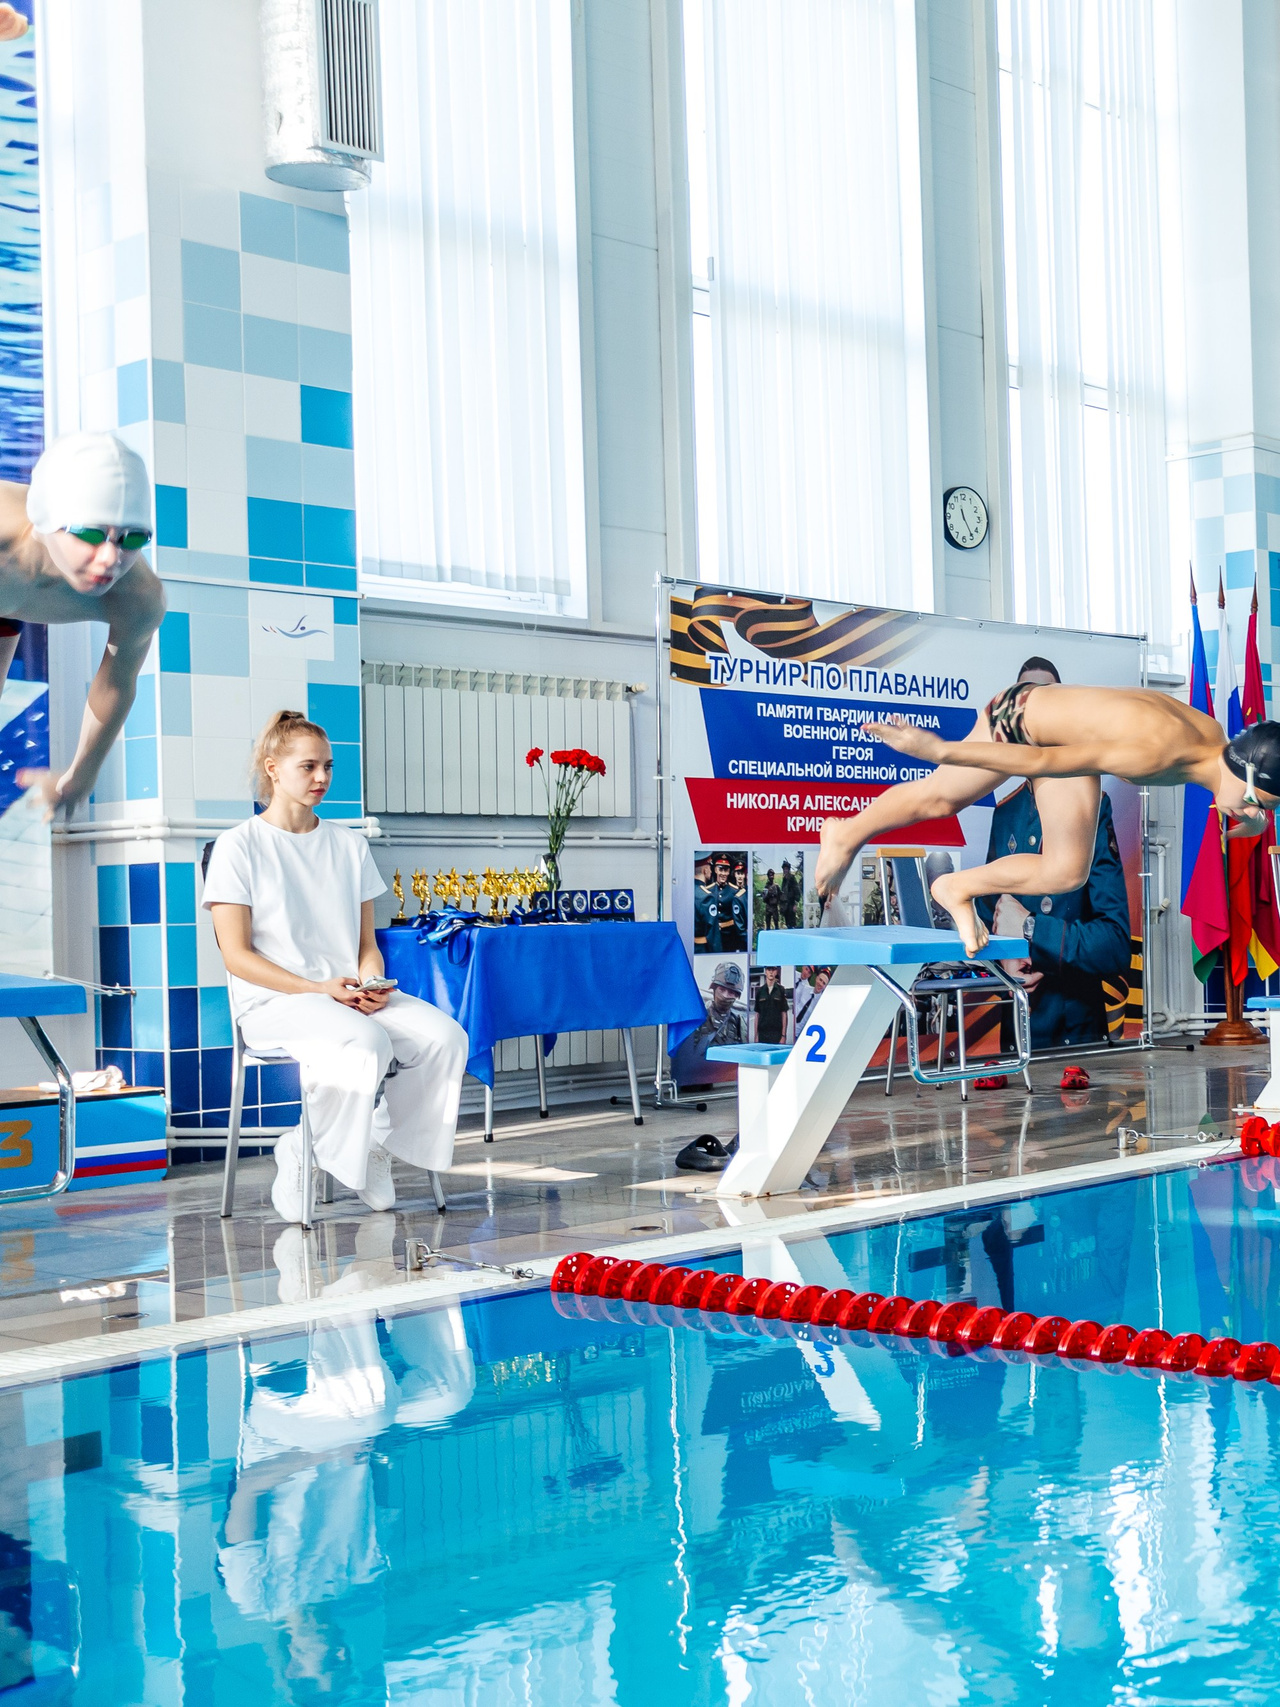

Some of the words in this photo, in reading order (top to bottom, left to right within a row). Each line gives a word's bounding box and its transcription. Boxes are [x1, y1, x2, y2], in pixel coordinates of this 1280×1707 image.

[708, 655, 802, 687] ТУРНИР
[810, 665, 842, 691] ПО
[850, 668, 969, 701] ПЛАВАНИЮ
[757, 702, 813, 721] ПАМЯТИ
[816, 706, 875, 726] ГВАРДИИ
[877, 711, 941, 729] КАПИТАНА
[783, 724, 848, 742] ВОЕННОЙ
[851, 728, 889, 744] РАЗВ
[832, 746, 874, 761] ГЕРОЯ
[728, 759, 833, 778] СПЕЦИАЛЬНОЙ
[836, 763, 897, 781] ВОЕННОЙ
[900, 767, 937, 781] ОПЕР
[726, 792, 799, 810] НИКОЛАЯ
[805, 1024, 827, 1063] 2
